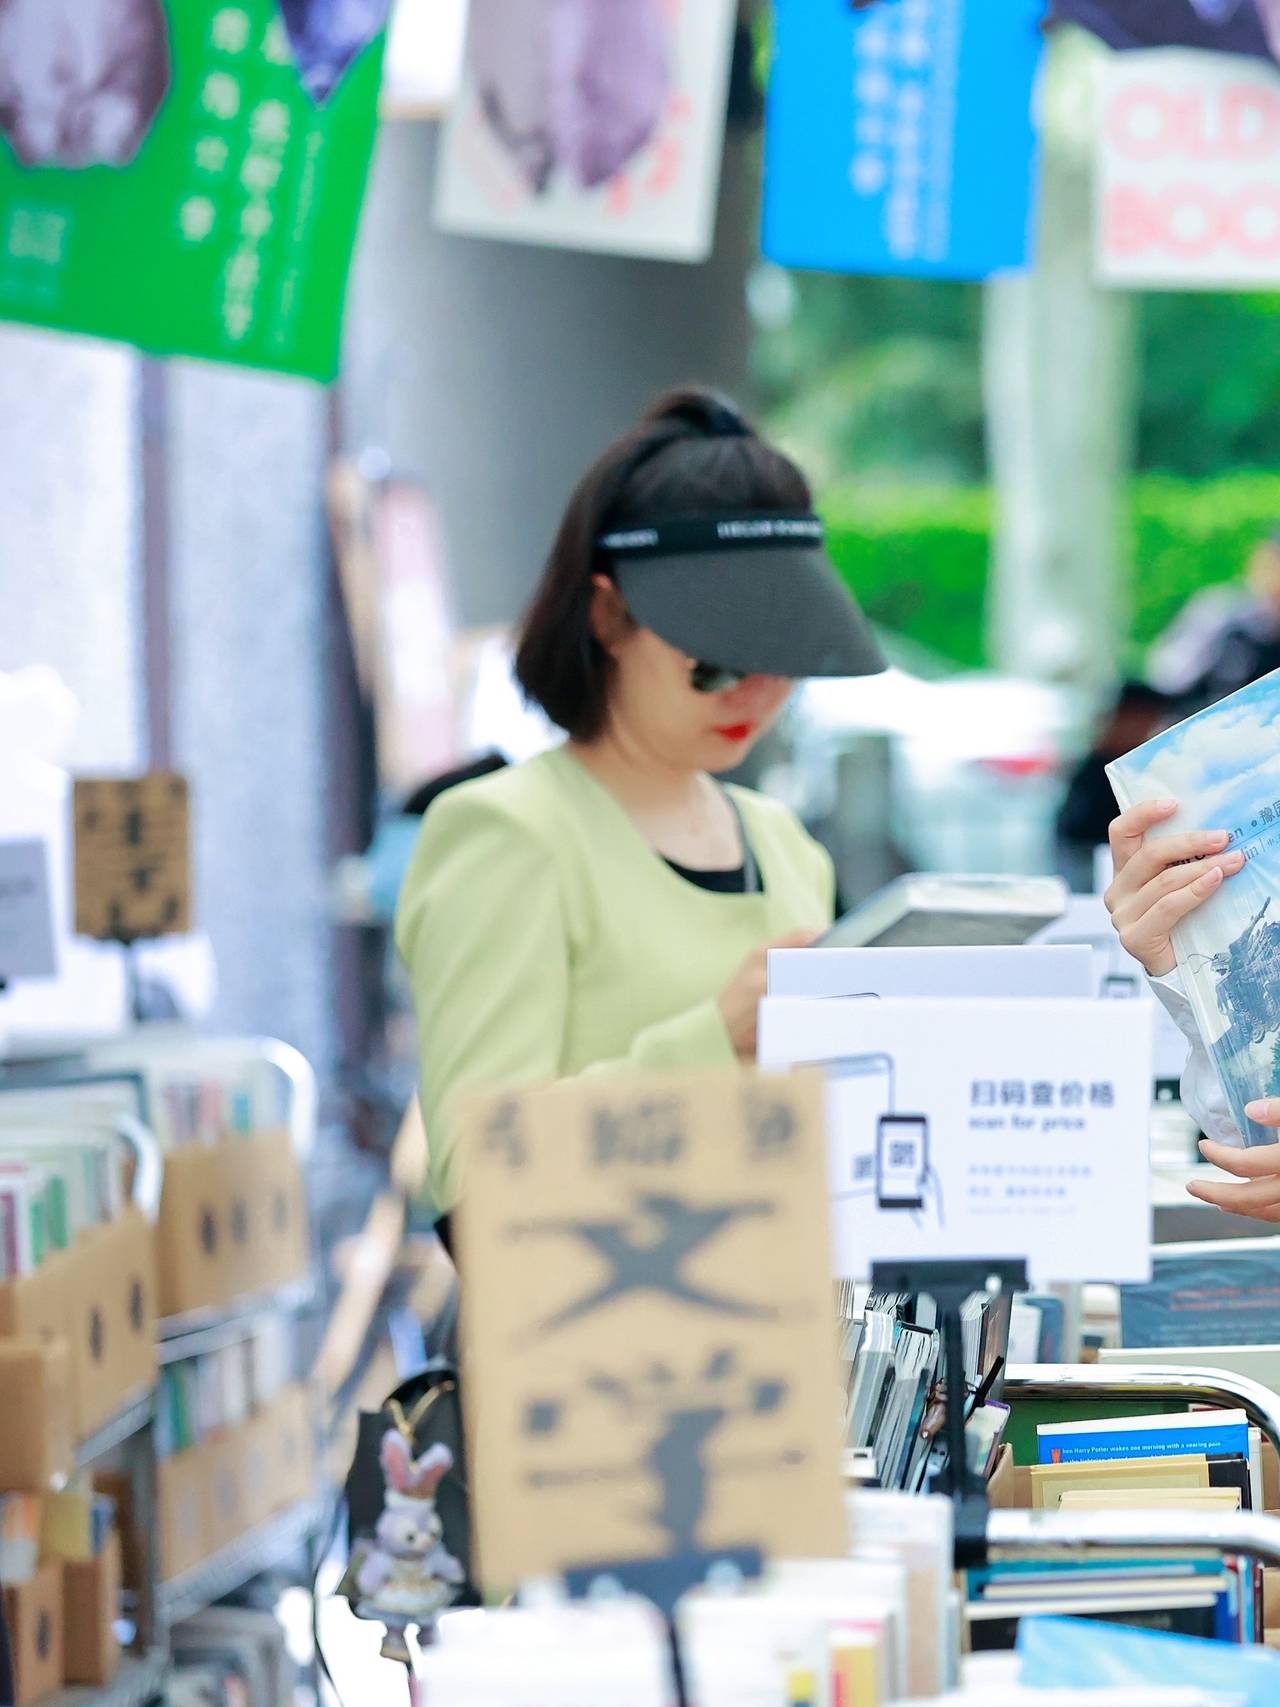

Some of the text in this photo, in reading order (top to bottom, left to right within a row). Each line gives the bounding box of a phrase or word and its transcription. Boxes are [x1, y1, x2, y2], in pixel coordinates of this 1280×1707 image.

[970, 1079, 1115, 1107] 扫码查价格
[968, 1112, 1086, 1133] scan for price
[1074, 1447, 1090, 1455] Harry
